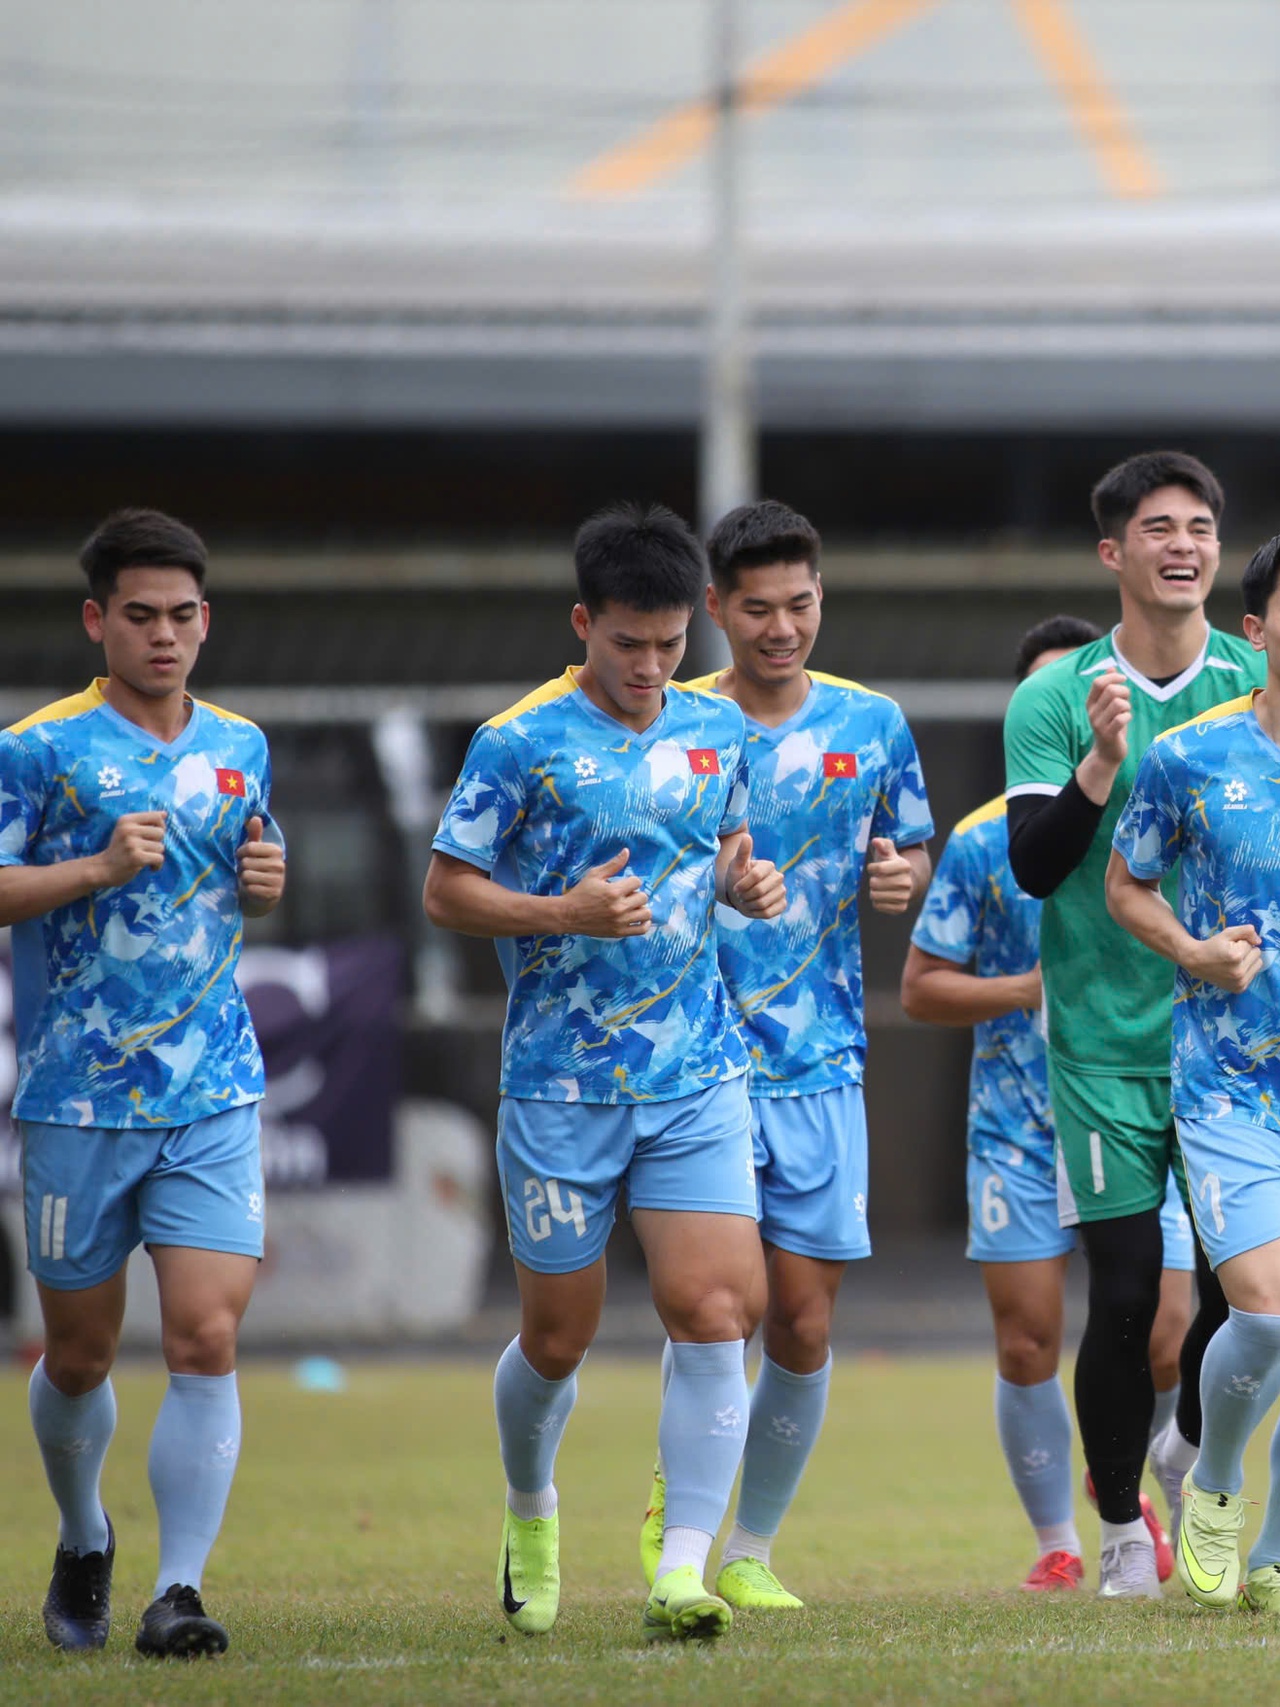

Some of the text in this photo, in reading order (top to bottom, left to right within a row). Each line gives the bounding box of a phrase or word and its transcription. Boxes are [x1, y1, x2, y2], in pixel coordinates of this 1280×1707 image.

[1089, 1131, 1105, 1194] 1
[40, 1194, 68, 1260] 11
[524, 1177, 587, 1242] 24
[981, 1174, 1009, 1233] 6
